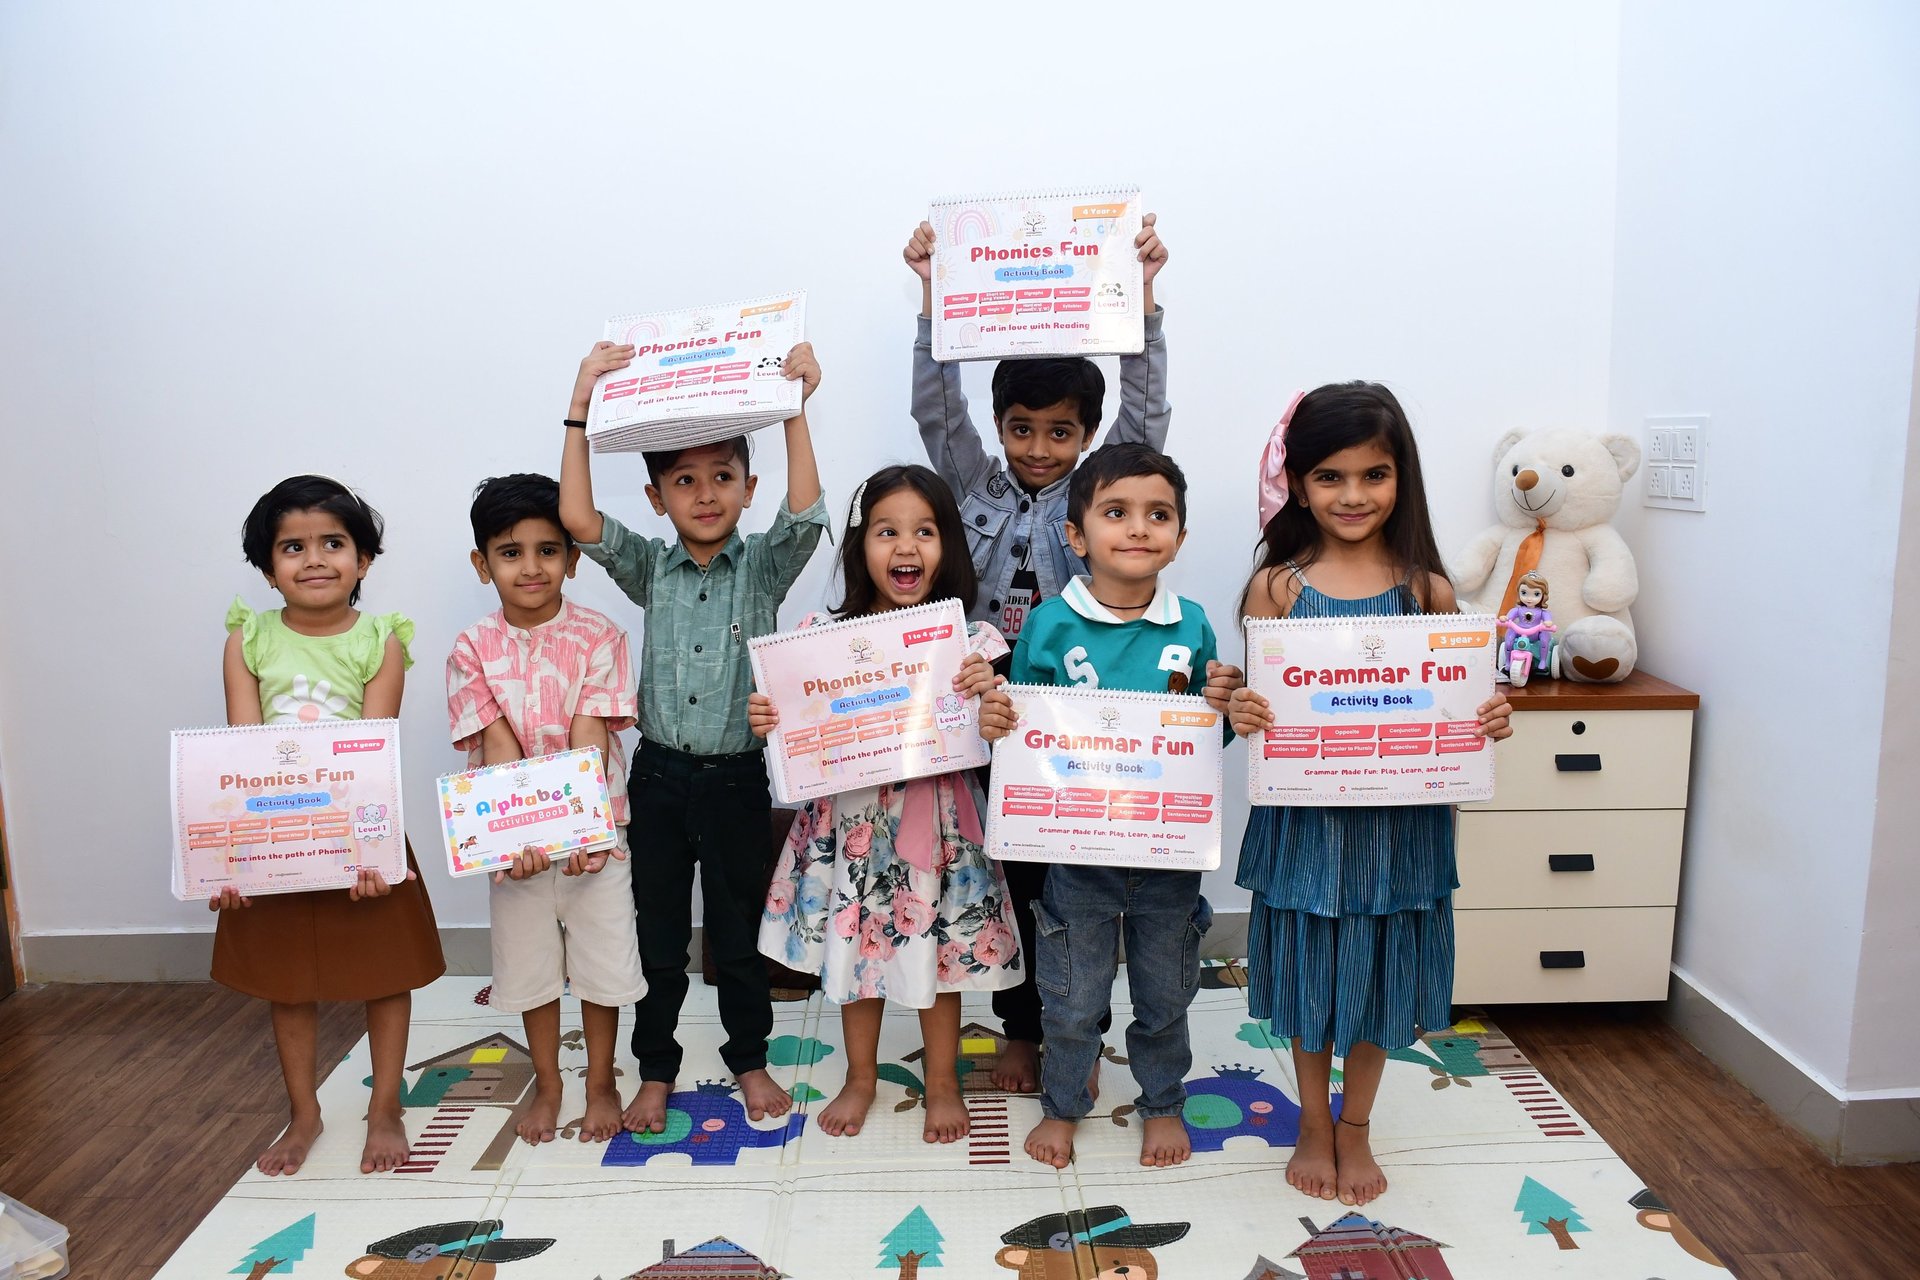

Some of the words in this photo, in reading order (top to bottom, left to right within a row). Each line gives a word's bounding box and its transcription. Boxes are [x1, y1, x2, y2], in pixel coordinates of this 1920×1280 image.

[1070, 226, 1077, 235] A
[971, 244, 1053, 262] Phonics
[1060, 242, 1099, 256] Fun
[1053, 322, 1090, 330] Reading
[639, 337, 718, 356] Phonics
[725, 330, 761, 342] Fun
[668, 352, 702, 362] Activity
[1003, 607, 1023, 634] 98
[929, 629, 948, 637] years
[1440, 636, 1446, 644] 3
[1450, 637, 1473, 645] year
[1063, 645, 1099, 689] S
[1283, 666, 1410, 687] Grammar
[1422, 662, 1466, 683] Fun
[804, 670, 885, 696] Phonics
[891, 662, 930, 678] Fun
[840, 697, 876, 708] Activity
[878, 692, 901, 700] Book
[1331, 696, 1378, 707] Activity
[1383, 695, 1413, 705] Book
[940, 715, 960, 723] Level
[840, 754, 855, 762] into
[873, 746, 892, 756] path
[904, 739, 936, 749] Phonics
[1024, 730, 1141, 753] Grammar
[1152, 736, 1194, 755] Fun
[1067, 760, 1111, 773] Activity
[1116, 763, 1143, 773] Book
[220, 771, 308, 790] Phonics
[316, 768, 354, 782] Fun
[256, 799, 294, 807] Activity
[476, 783, 572, 816] Alphabet
[492, 814, 537, 830] Activity
[538, 806, 564, 820] Book
[285, 850, 304, 859] path
